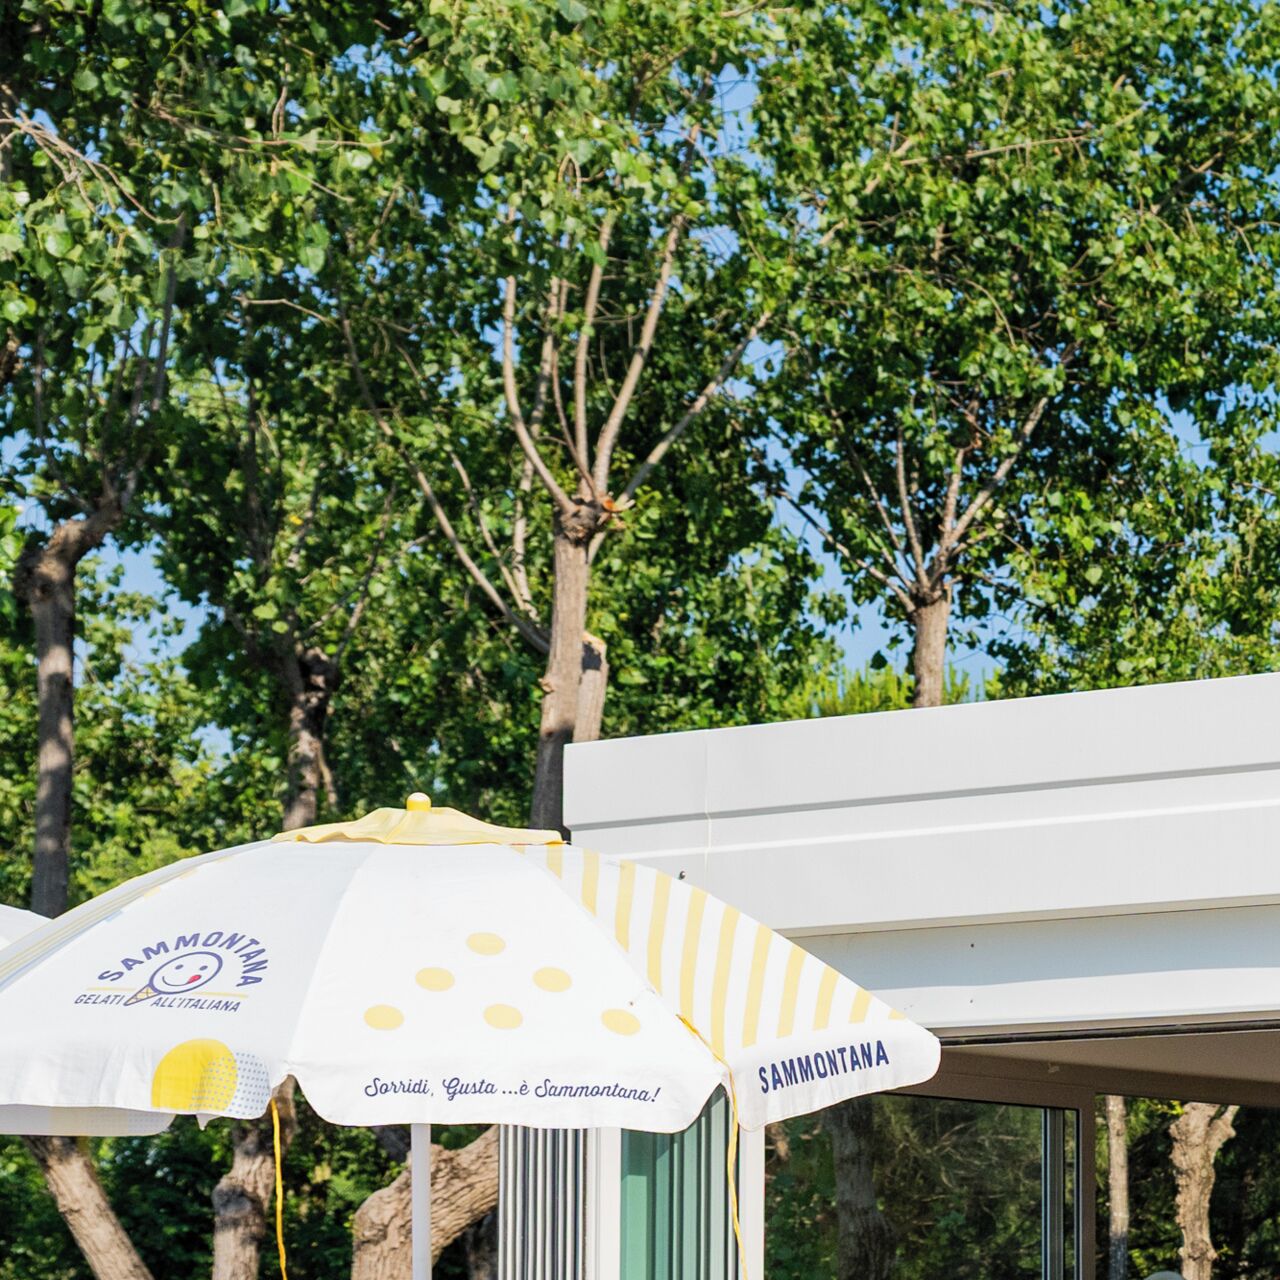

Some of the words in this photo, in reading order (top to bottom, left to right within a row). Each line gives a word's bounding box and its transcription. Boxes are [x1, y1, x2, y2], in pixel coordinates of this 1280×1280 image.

[97, 931, 269, 988] SAMMONTANA
[74, 993, 126, 1005] GELATI
[150, 996, 241, 1013] ALL'ITALIANA
[758, 1039, 890, 1094] SAMMONTANA
[442, 1076, 498, 1102] Gusta
[534, 1078, 662, 1103] Sammontana!
